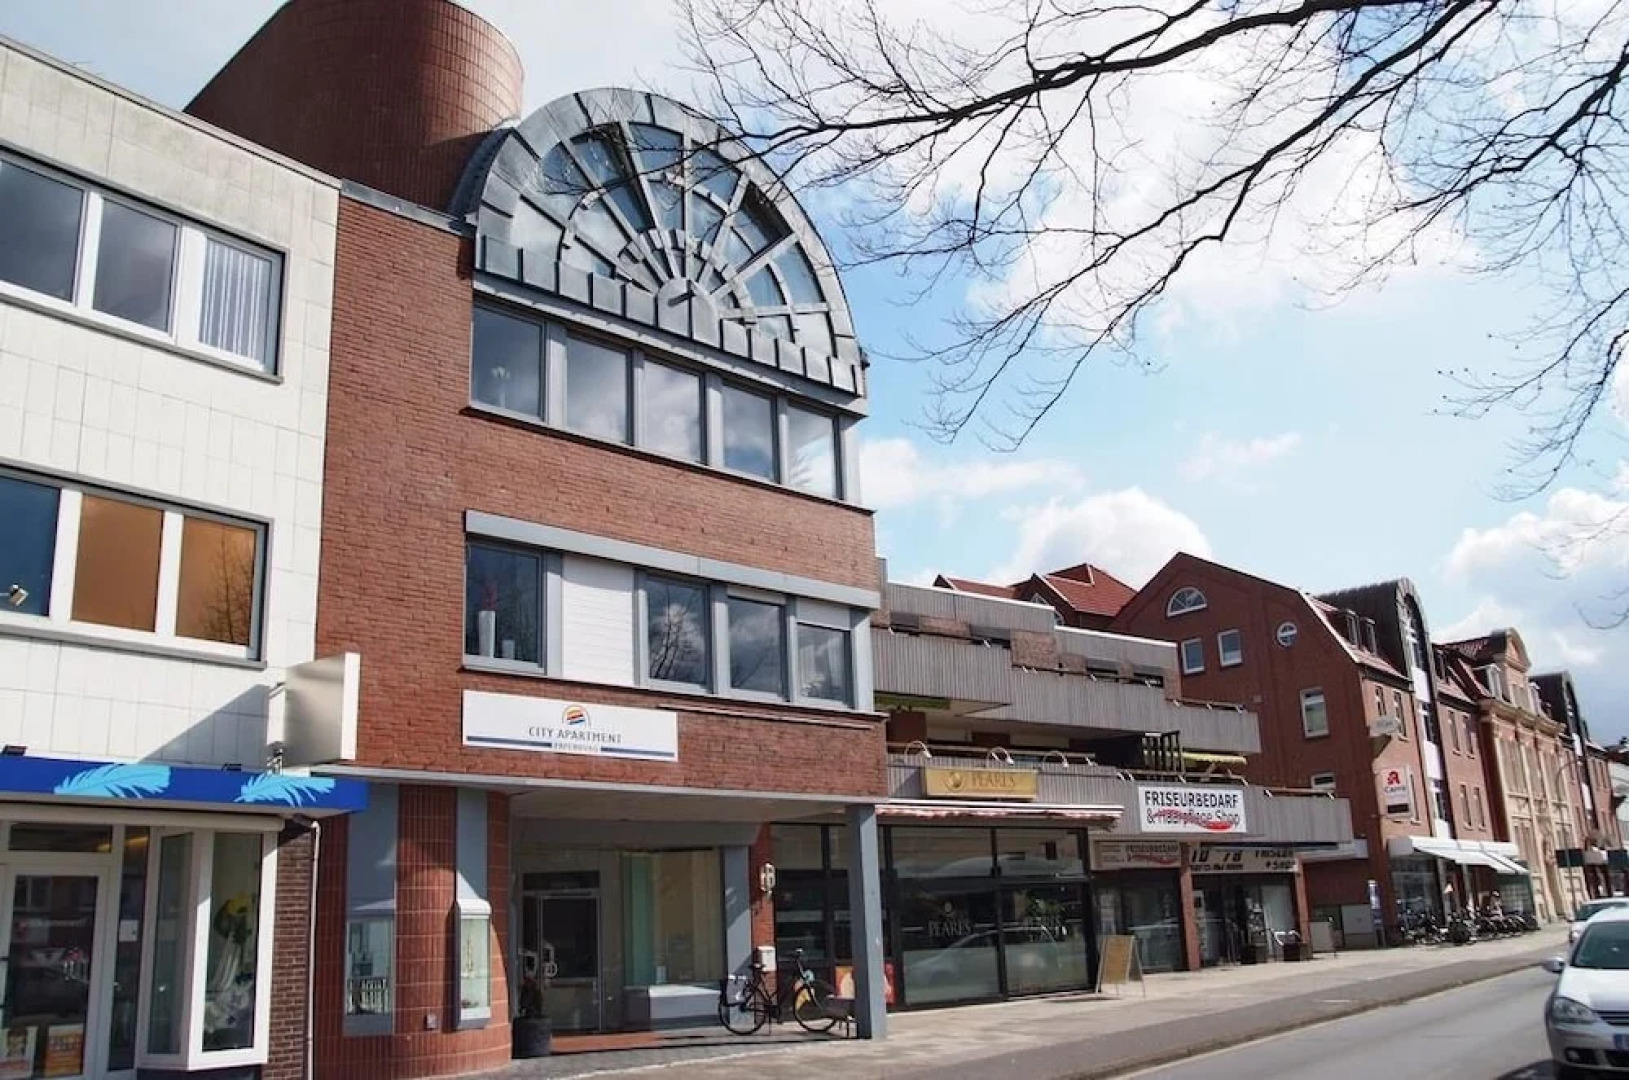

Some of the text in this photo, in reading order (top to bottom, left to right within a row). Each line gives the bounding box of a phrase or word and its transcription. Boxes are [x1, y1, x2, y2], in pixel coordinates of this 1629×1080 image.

[528, 726, 622, 744] CITY APARTMENT
[1144, 790, 1239, 808] FRISEURBEDARF
[1146, 808, 1155, 824] &
[1214, 809, 1240, 829] Shop
